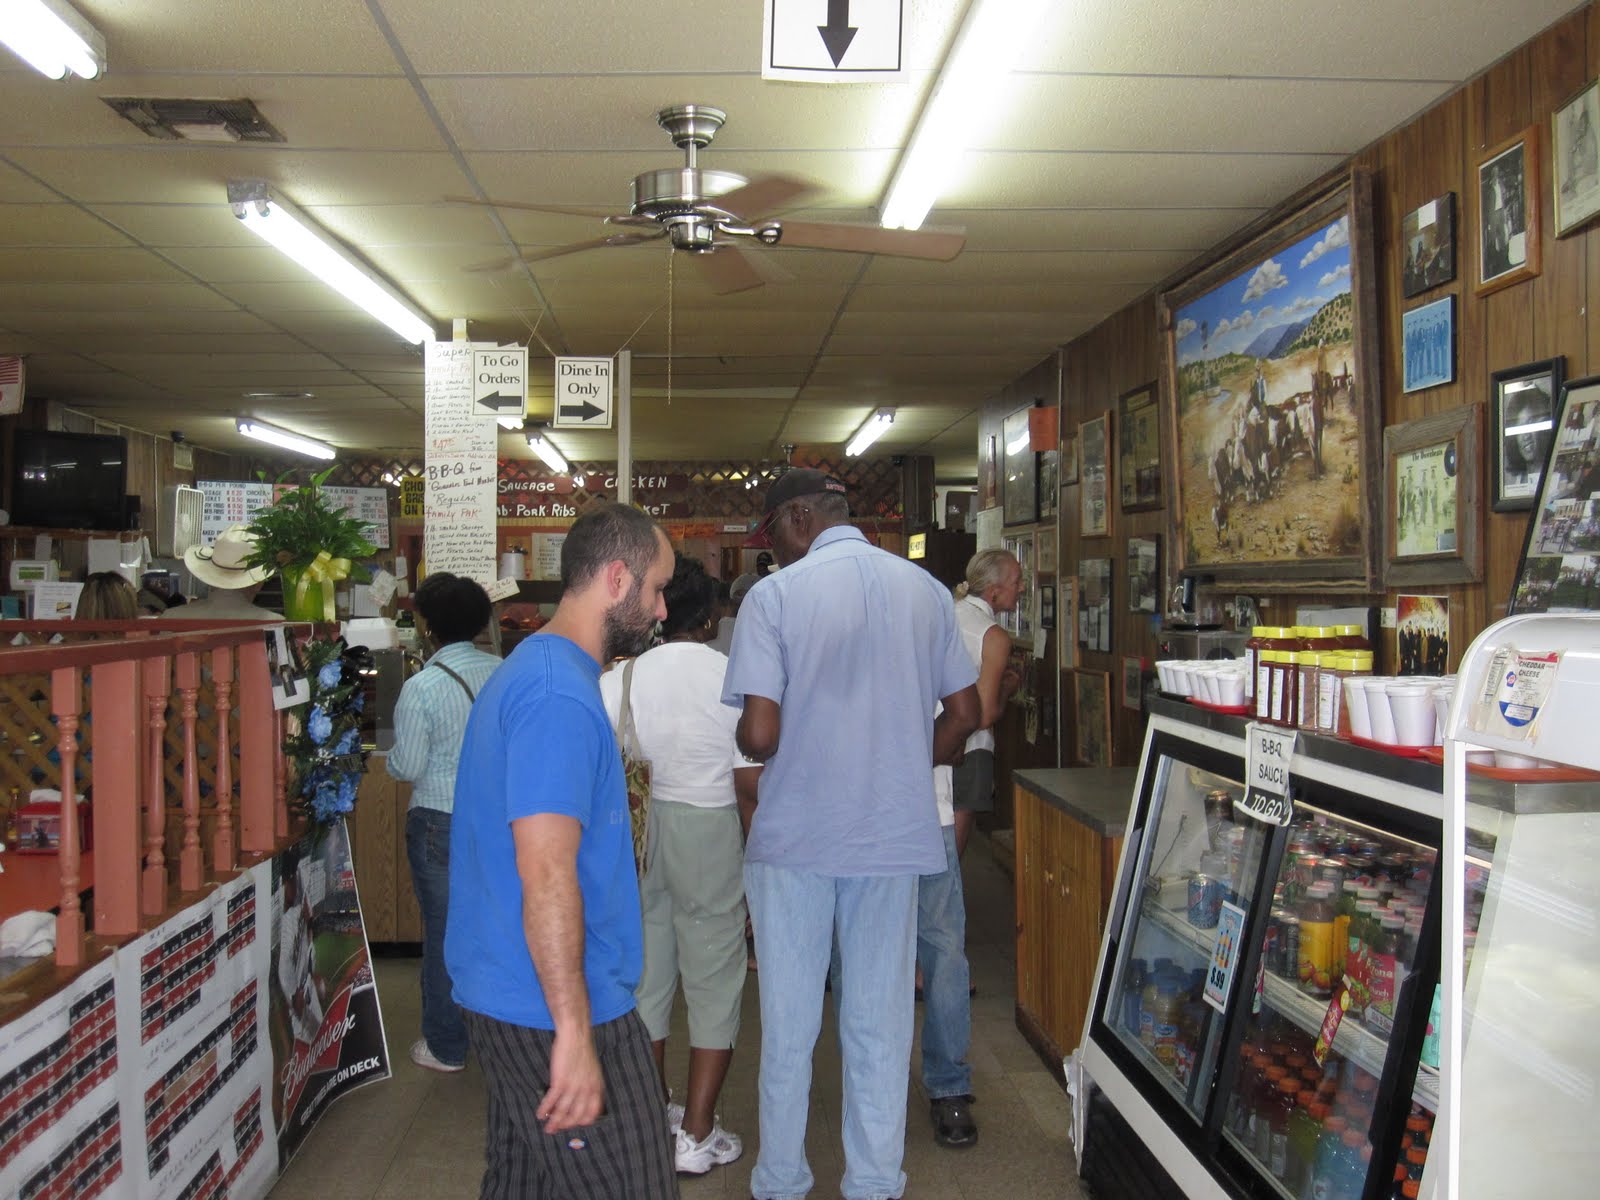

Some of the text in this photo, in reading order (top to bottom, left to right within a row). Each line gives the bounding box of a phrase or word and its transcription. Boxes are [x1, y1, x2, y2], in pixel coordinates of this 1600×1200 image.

[480, 355, 519, 367] To Go
[561, 364, 608, 376] Dine In
[479, 372, 521, 384] Orders
[567, 382, 600, 398] Only
[404, 504, 418, 515] ON
[551, 503, 576, 517] Ribs
[1518, 660, 1546, 670] CHEDDAR
[1518, 669, 1541, 679] CHEESE
[1261, 738, 1283, 758] B-B-Q
[1251, 794, 1283, 818] TO GO
[1210, 966, 1226, 991] $.99
[281, 1014, 356, 1102] Budweiser
[337, 1068, 350, 1083] ON
[350, 1056, 381, 1077] DECK
